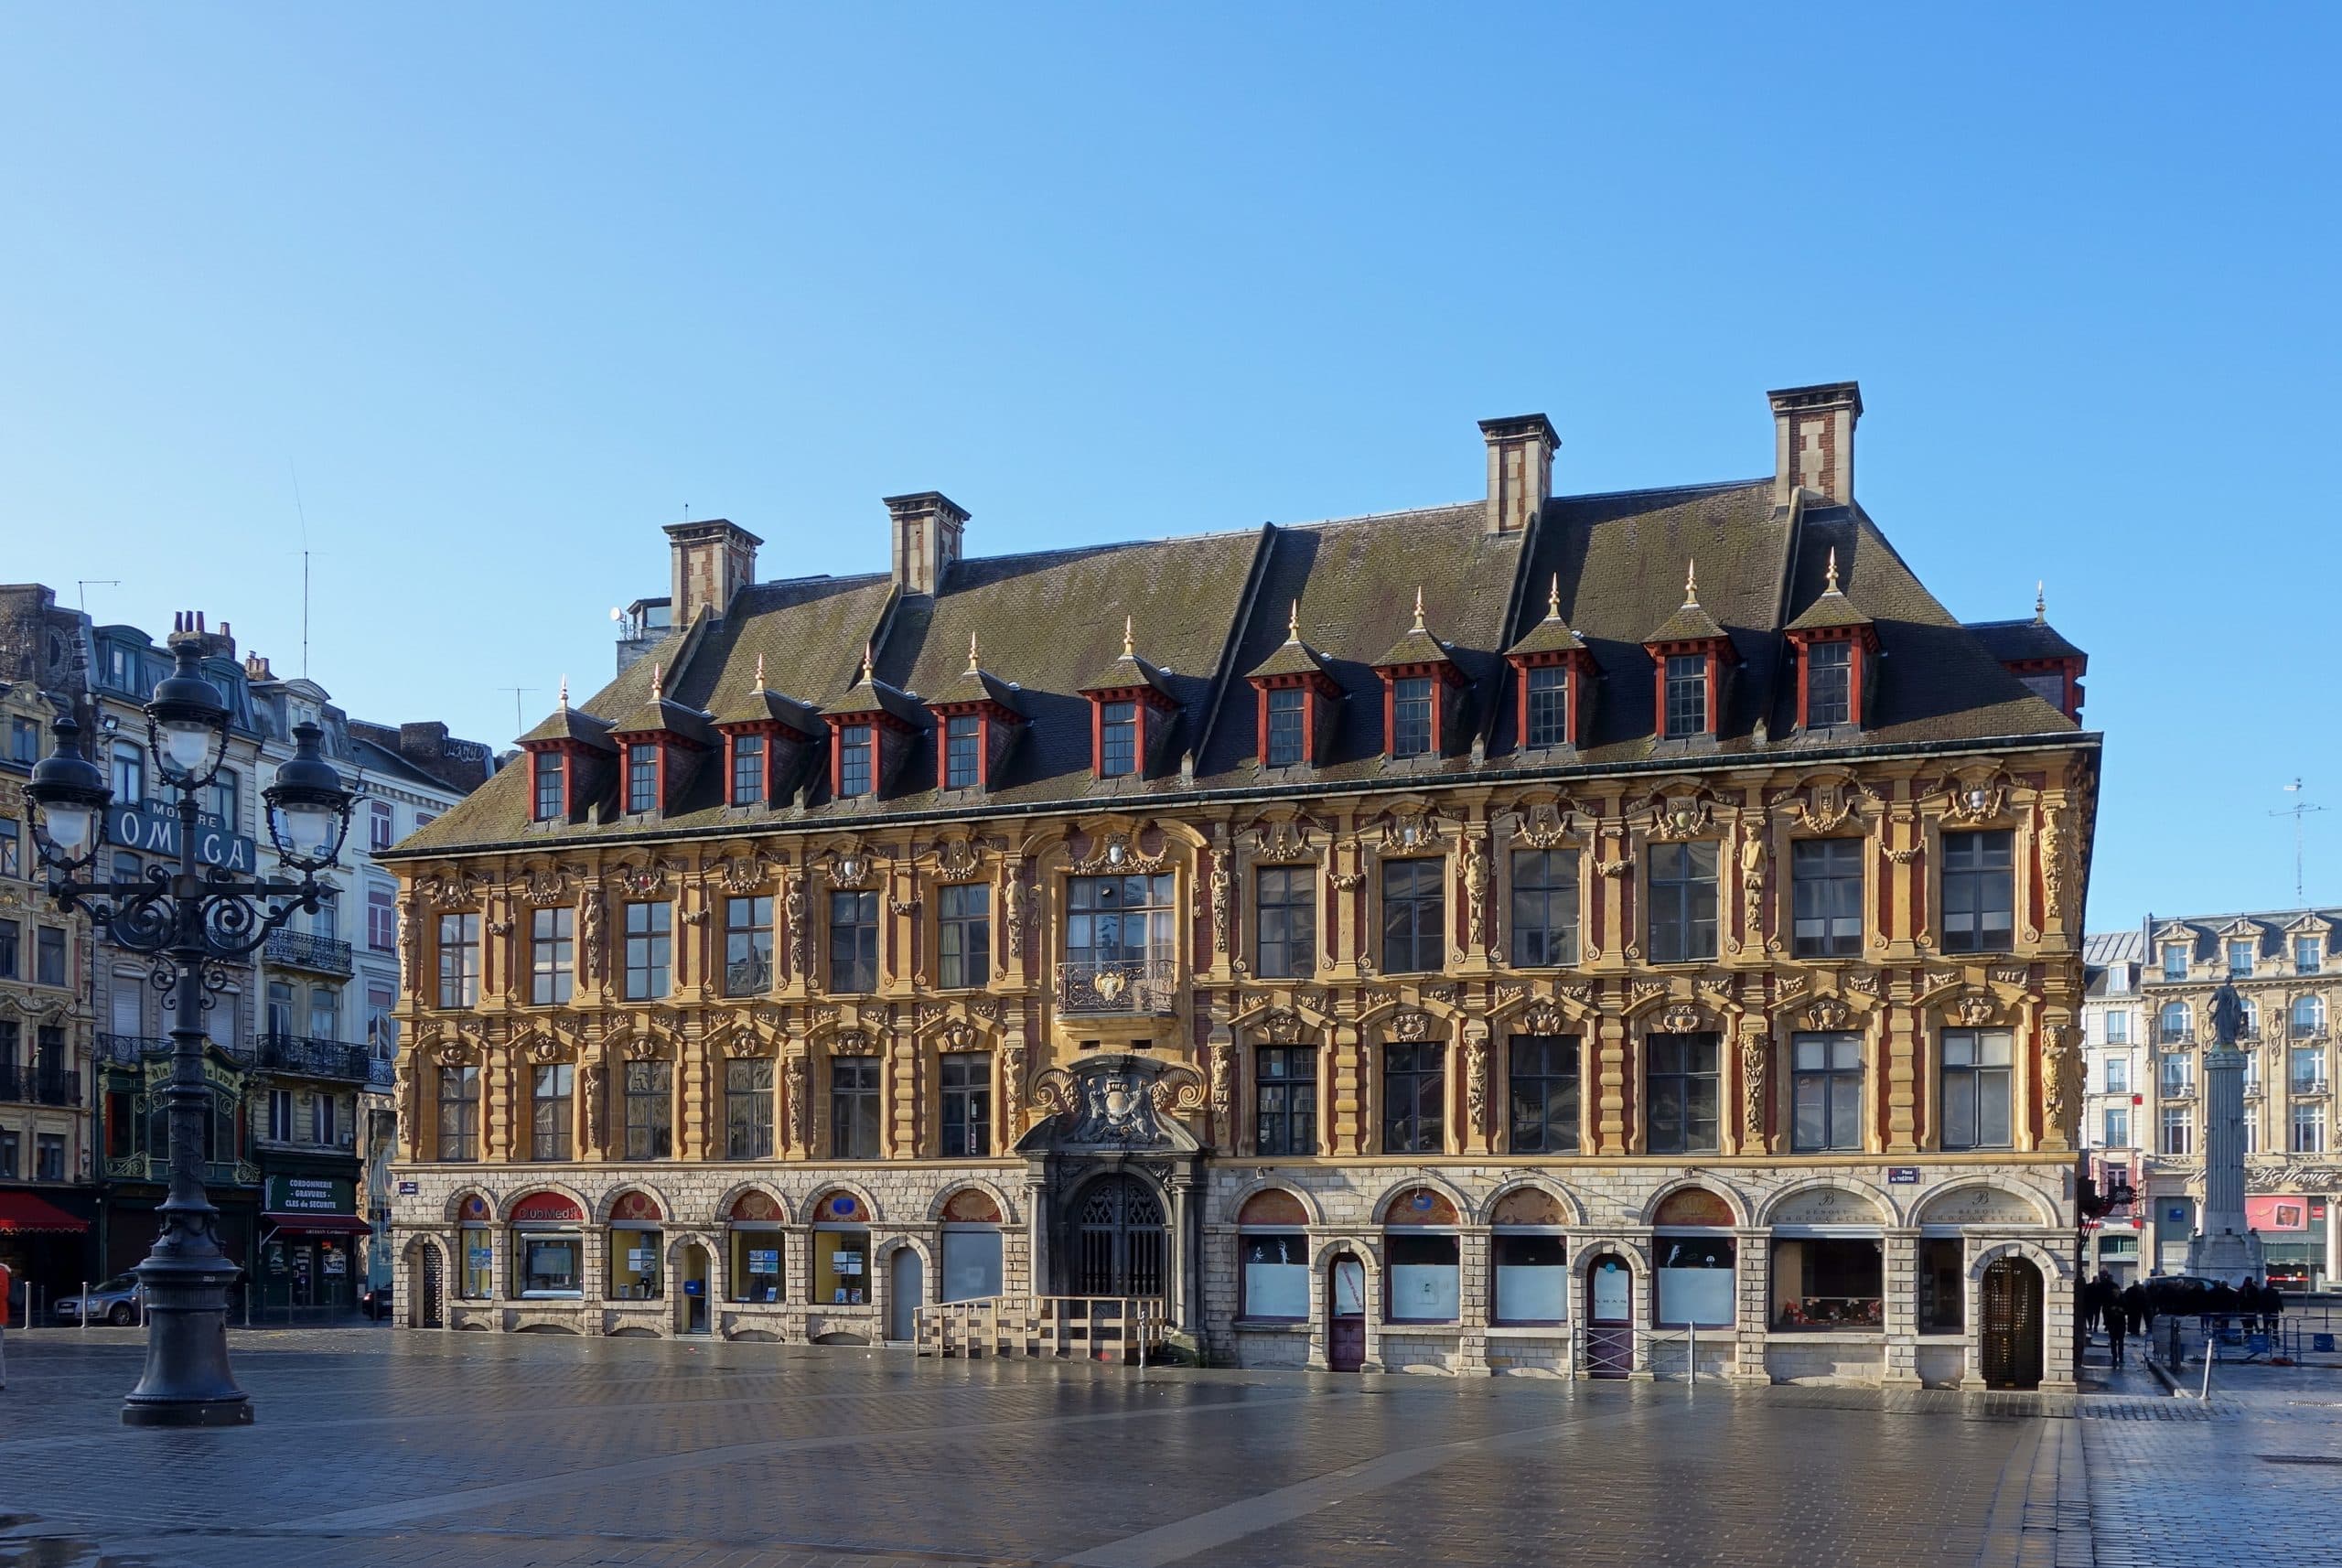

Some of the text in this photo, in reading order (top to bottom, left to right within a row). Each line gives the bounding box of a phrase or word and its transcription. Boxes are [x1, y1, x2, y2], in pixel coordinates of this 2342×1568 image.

[153, 803, 217, 828] MORE
[121, 811, 244, 868] OMGA
[2247, 1165, 2337, 1184] Bellevue
[289, 1179, 333, 1188] CORDONNERIE
[295, 1189, 327, 1198] GRAVURES
[285, 1199, 337, 1208] CLES de SECURITE
[519, 1207, 570, 1219] Club Med
